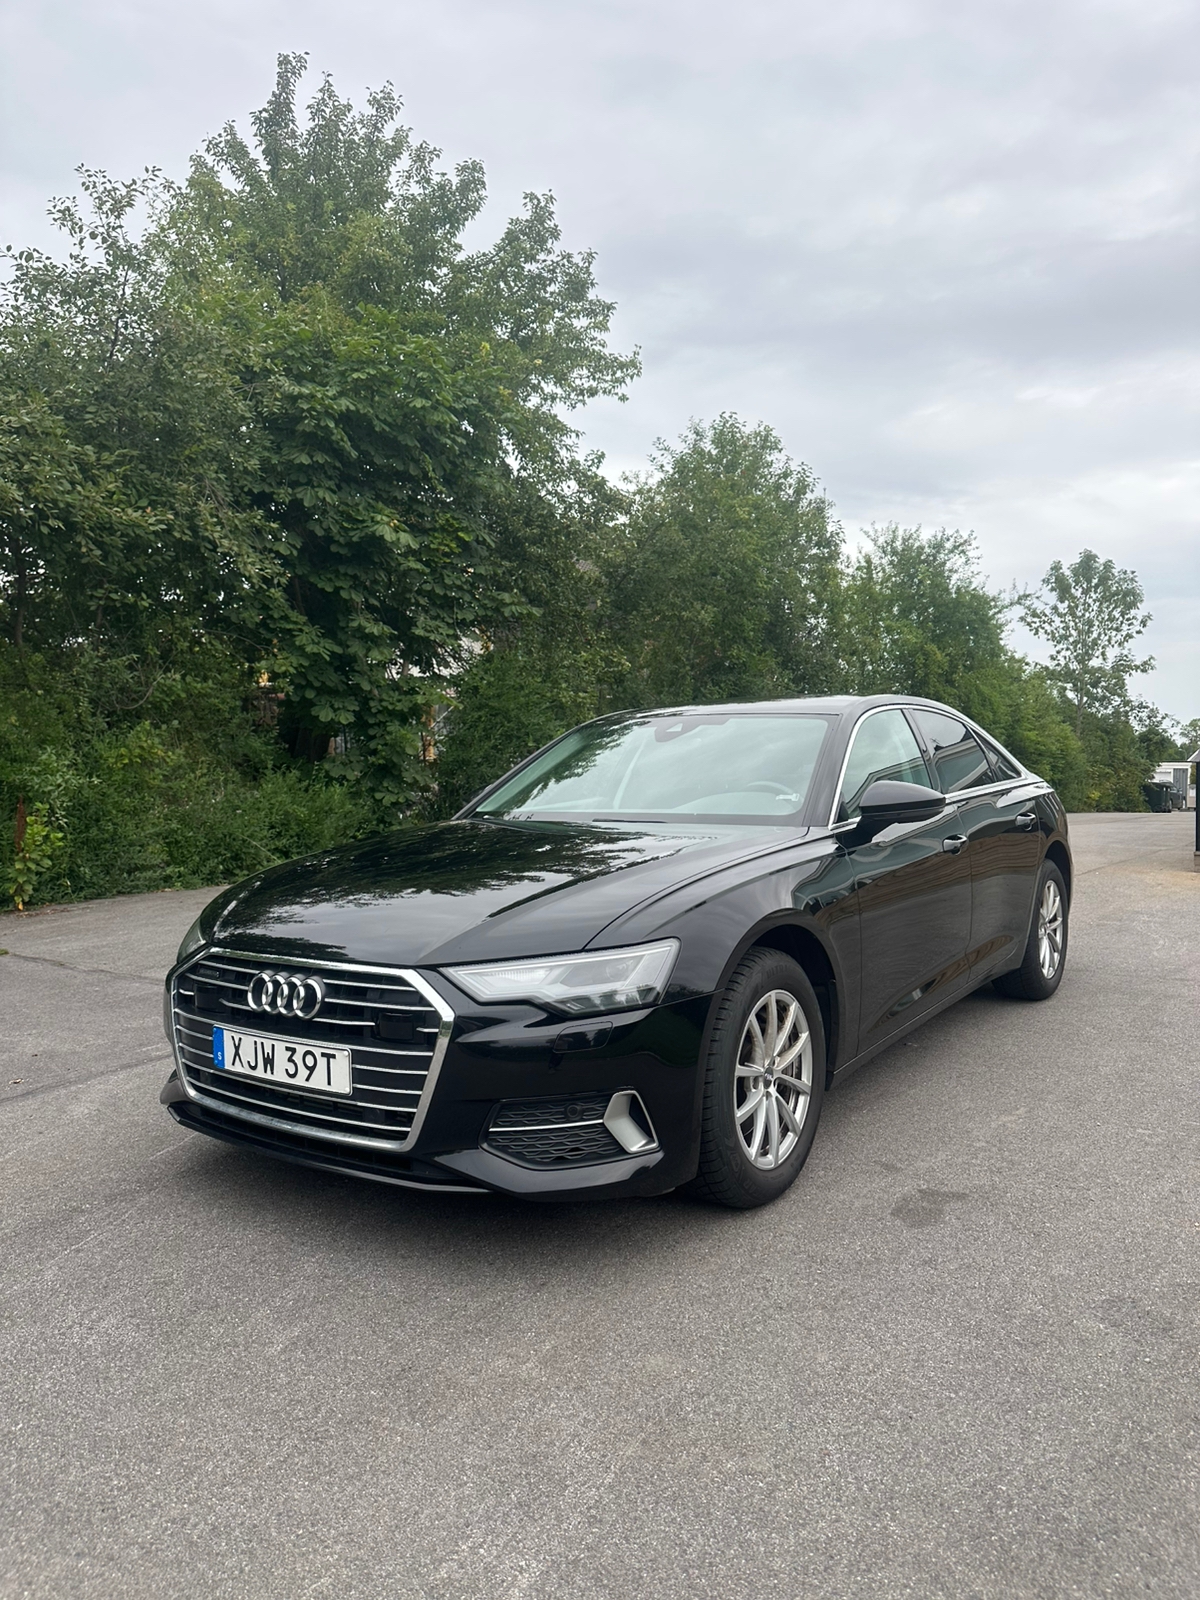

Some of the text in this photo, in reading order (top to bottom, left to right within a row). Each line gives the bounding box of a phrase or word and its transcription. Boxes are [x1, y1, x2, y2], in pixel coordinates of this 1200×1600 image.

[217, 1051, 222, 1060] S
[231, 1035, 336, 1086] XJW 39T
